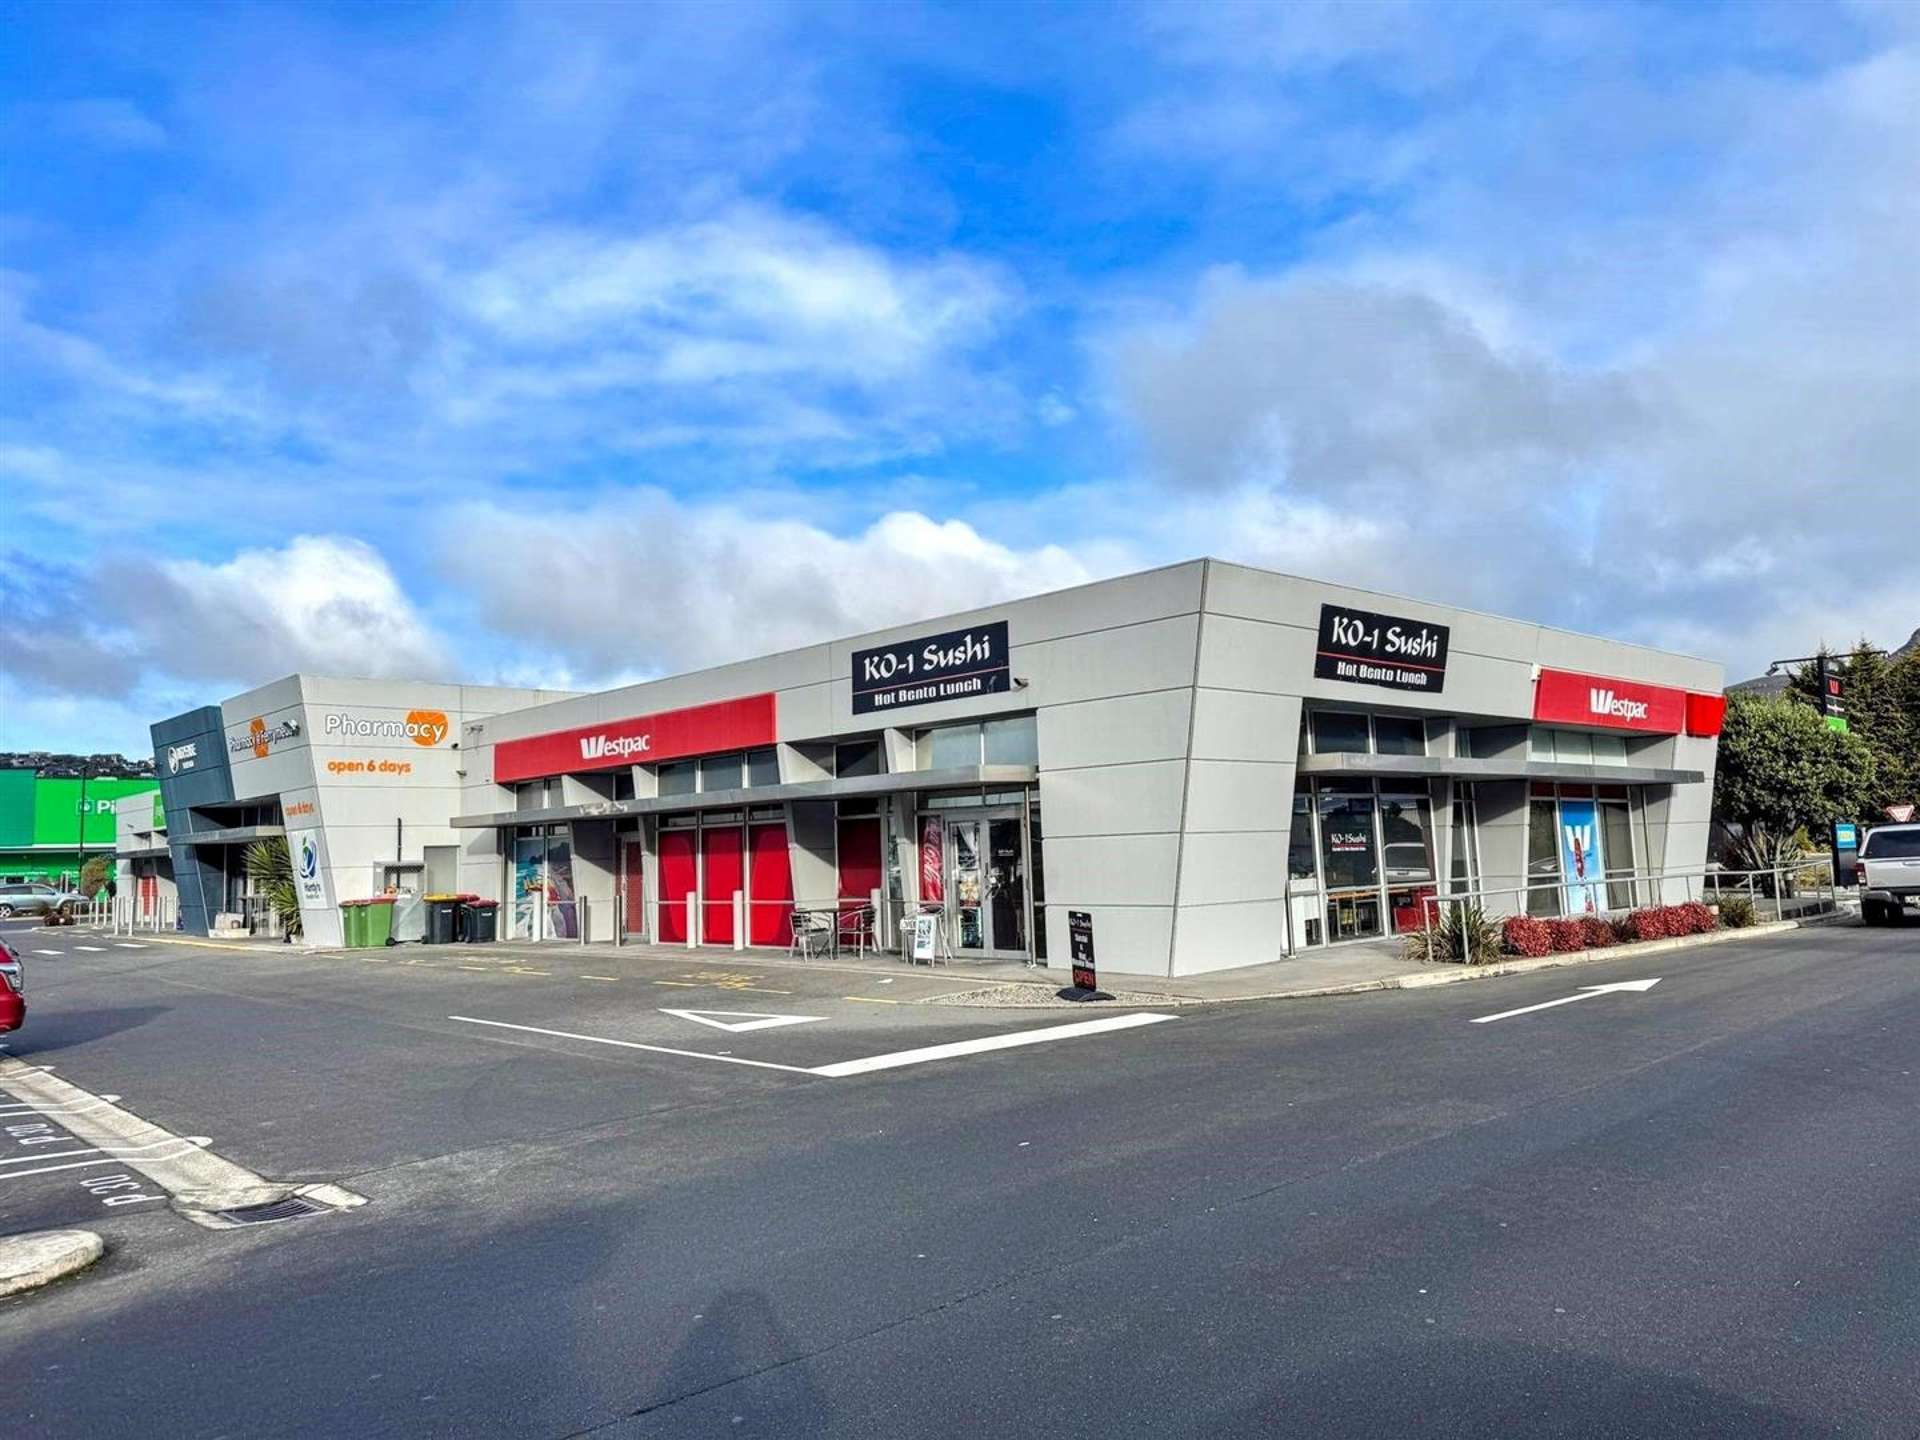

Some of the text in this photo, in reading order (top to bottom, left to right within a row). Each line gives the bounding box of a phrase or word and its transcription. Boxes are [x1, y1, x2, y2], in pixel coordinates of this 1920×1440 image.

[1331, 615, 1439, 658] KO-1 Sushi
[863, 633, 991, 682] KO-1 Sushi
[1337, 661, 1428, 686] Hot Bento Lunch
[874, 677, 982, 707] Hot Bento Lunch
[1590, 687, 1649, 723] Westpac
[324, 713, 445, 743] Pharmacy
[580, 734, 651, 759] Westpac
[327, 760, 412, 775] open 6 days
